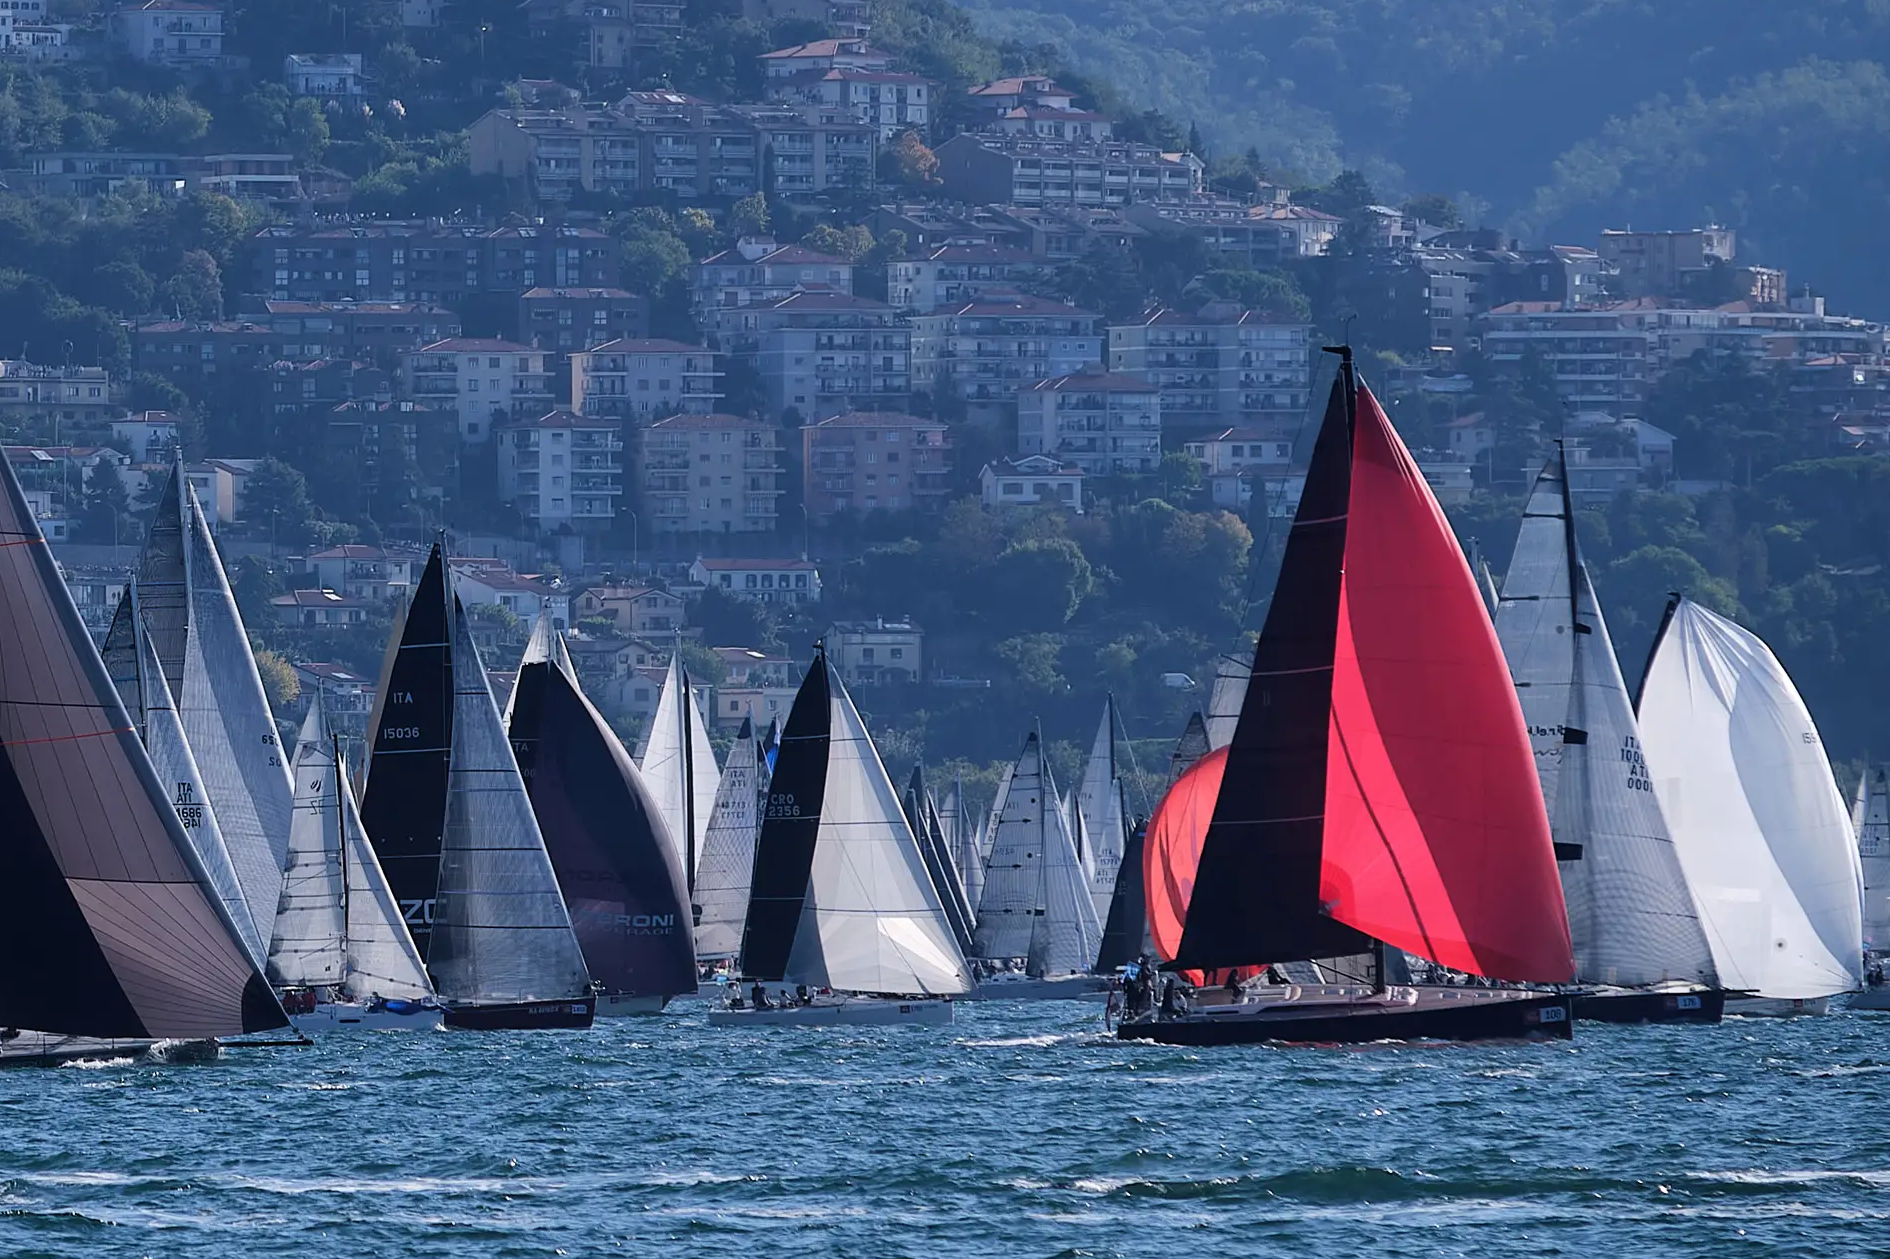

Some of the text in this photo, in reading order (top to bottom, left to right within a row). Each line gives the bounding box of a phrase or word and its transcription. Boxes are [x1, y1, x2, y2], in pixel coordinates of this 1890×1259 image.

[393, 692, 413, 704] ITA
[384, 727, 419, 739] 15036
[513, 742, 530, 752] TA
[178, 782, 193, 793] ITA
[771, 794, 795, 805] CRO
[769, 806, 800, 816] 2356
